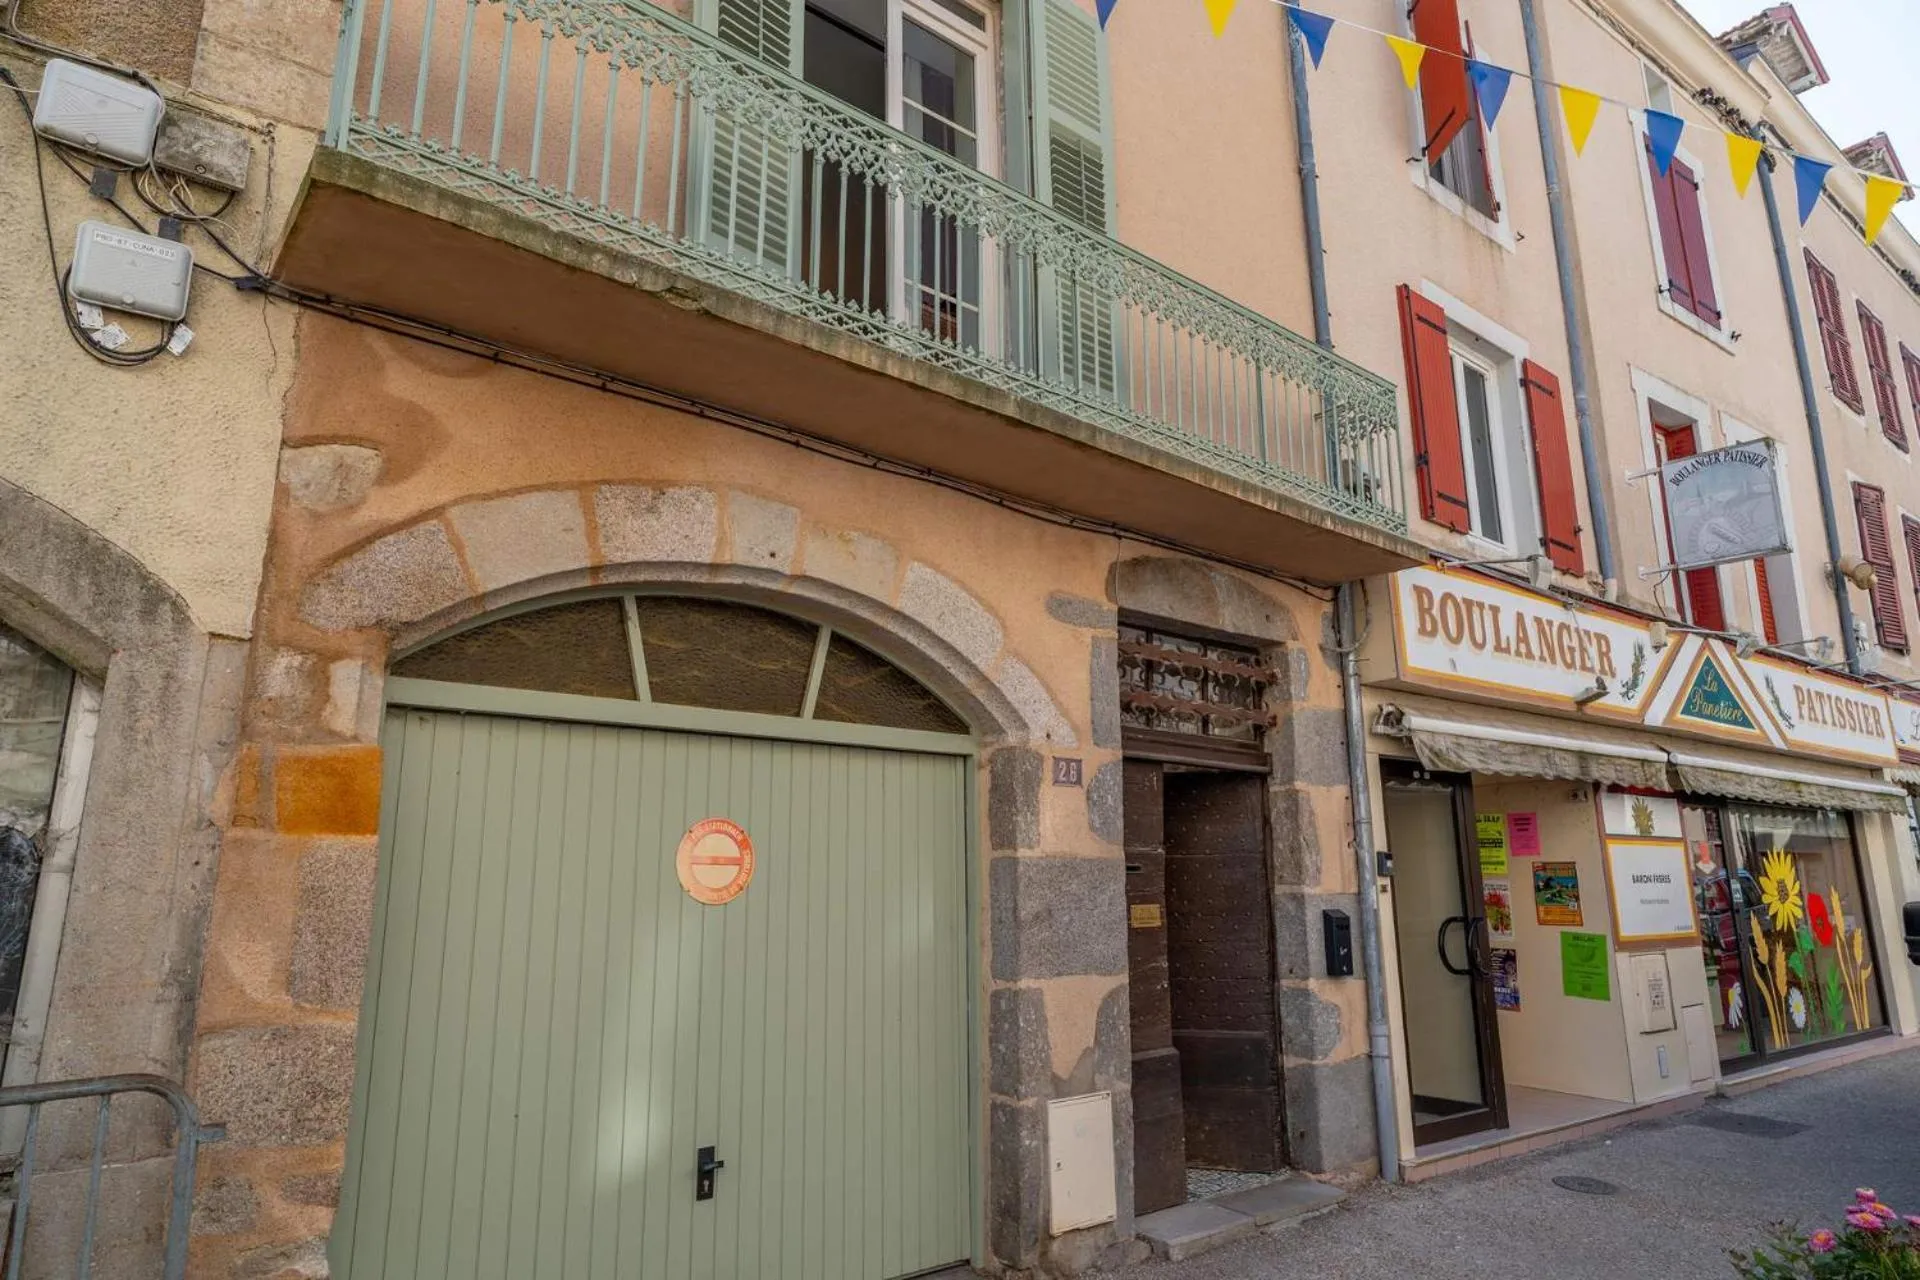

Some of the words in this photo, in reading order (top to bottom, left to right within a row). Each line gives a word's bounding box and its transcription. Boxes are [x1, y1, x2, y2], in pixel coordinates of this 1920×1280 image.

[1669, 453, 1721, 487] BOULANGER
[1724, 449, 1768, 469] PATISSIER
[1412, 584, 1616, 678] BOULANGER
[1703, 665, 1718, 693] La
[1793, 684, 1886, 738] PATISSIER
